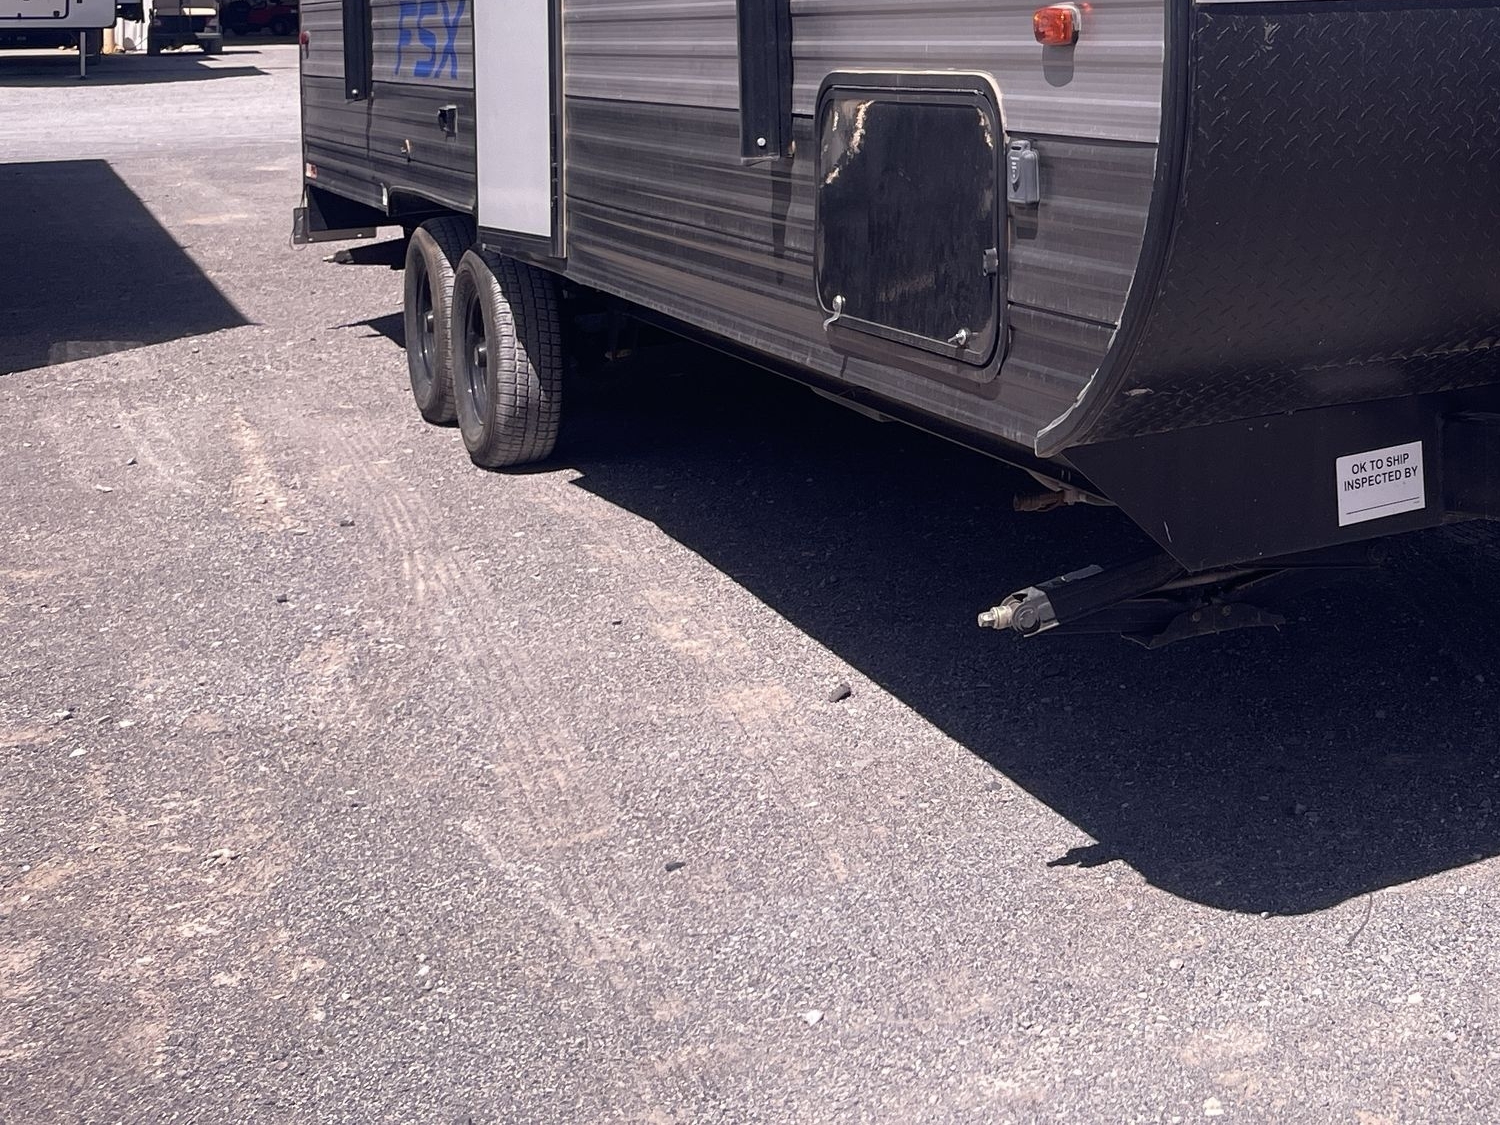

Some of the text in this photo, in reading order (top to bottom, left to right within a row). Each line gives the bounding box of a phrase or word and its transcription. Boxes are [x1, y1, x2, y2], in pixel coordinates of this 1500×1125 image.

[1352, 453, 1409, 474] OK TO SHIP
[1344, 465, 1418, 491] INSPECTED BY
